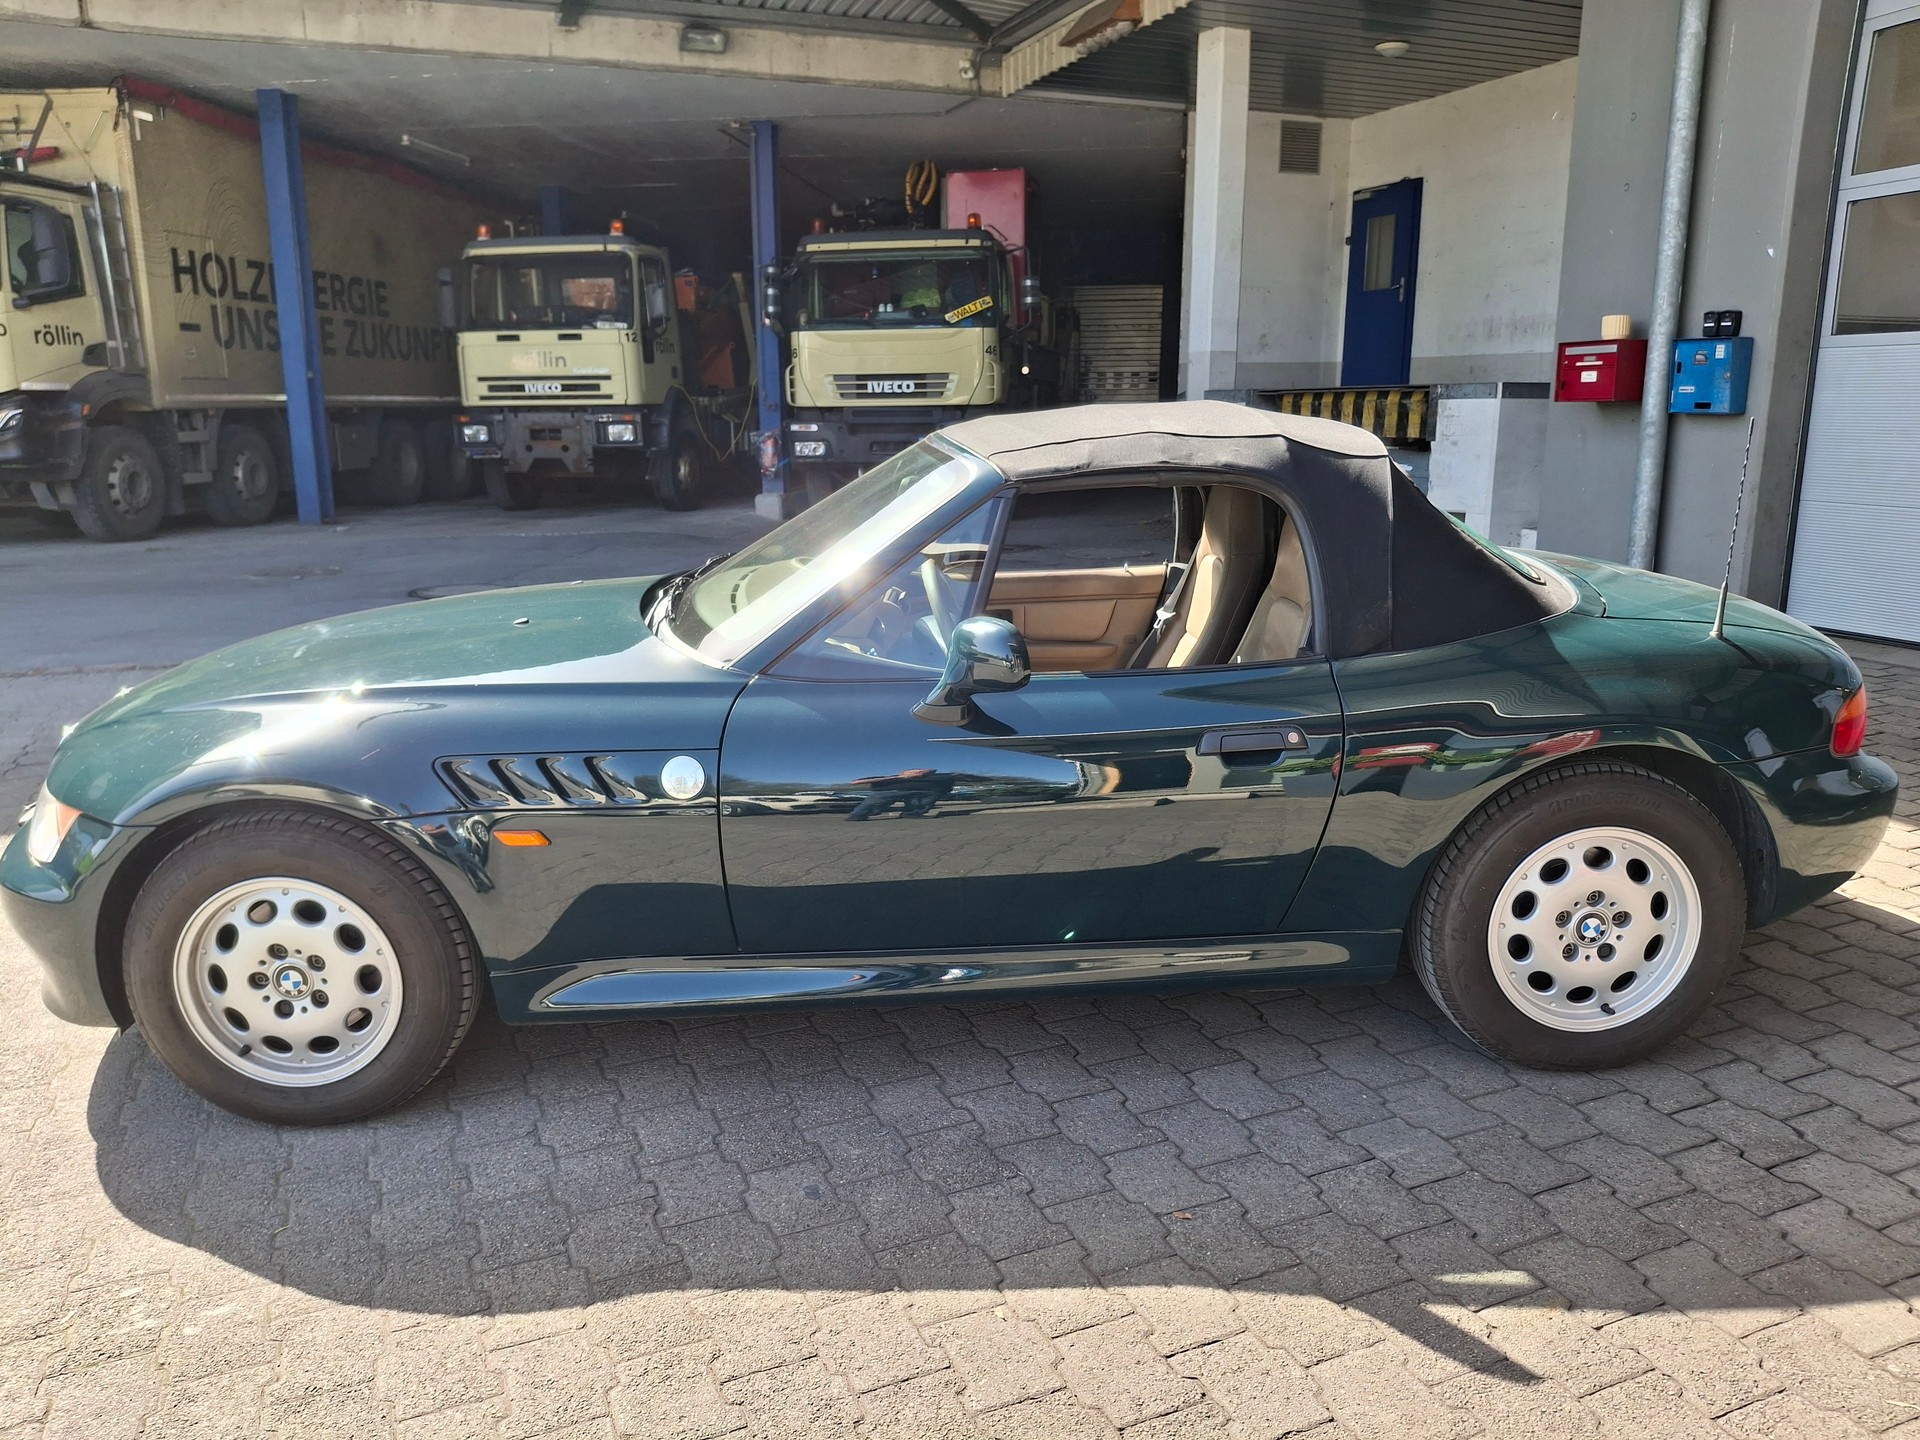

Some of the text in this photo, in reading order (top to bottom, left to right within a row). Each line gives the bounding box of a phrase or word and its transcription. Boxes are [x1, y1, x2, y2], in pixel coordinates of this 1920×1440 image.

[170, 247, 390, 317] HOLZERGIE
[34, 324, 84, 346] röllin
[210, 304, 338, 357] UNSE
[624, 332, 639, 343] 12
[524, 383, 563, 394] IVECO
[867, 380, 916, 393] IVECO
